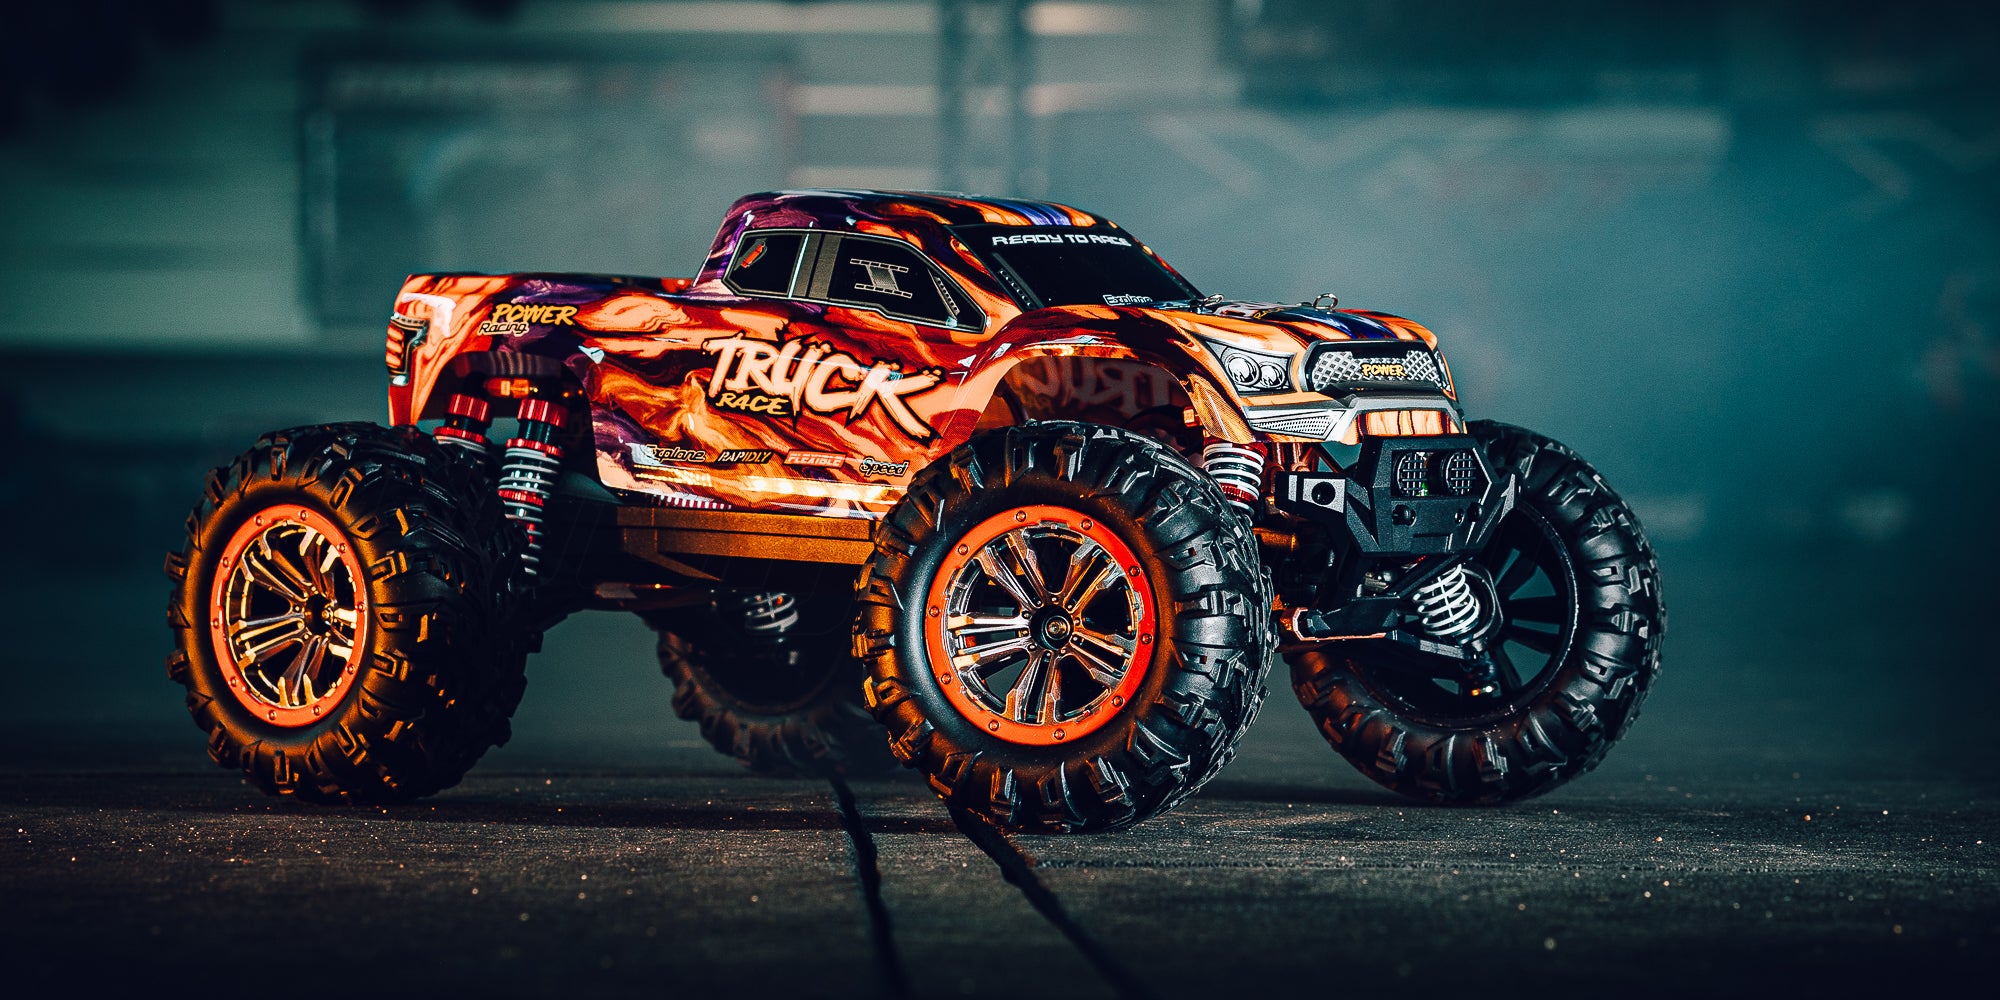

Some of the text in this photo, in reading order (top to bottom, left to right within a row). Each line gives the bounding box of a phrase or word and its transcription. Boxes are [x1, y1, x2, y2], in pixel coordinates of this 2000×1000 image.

[992, 234, 1132, 247] READY TO RACE
[491, 303, 578, 326] POWER
[477, 321, 530, 337] Racing
[1361, 363, 1407, 377] POWER
[702, 332, 942, 439] TRUCK
[715, 392, 791, 416] RACE
[717, 451, 772, 463] RAPIDLY
[860, 457, 909, 477] Speed
